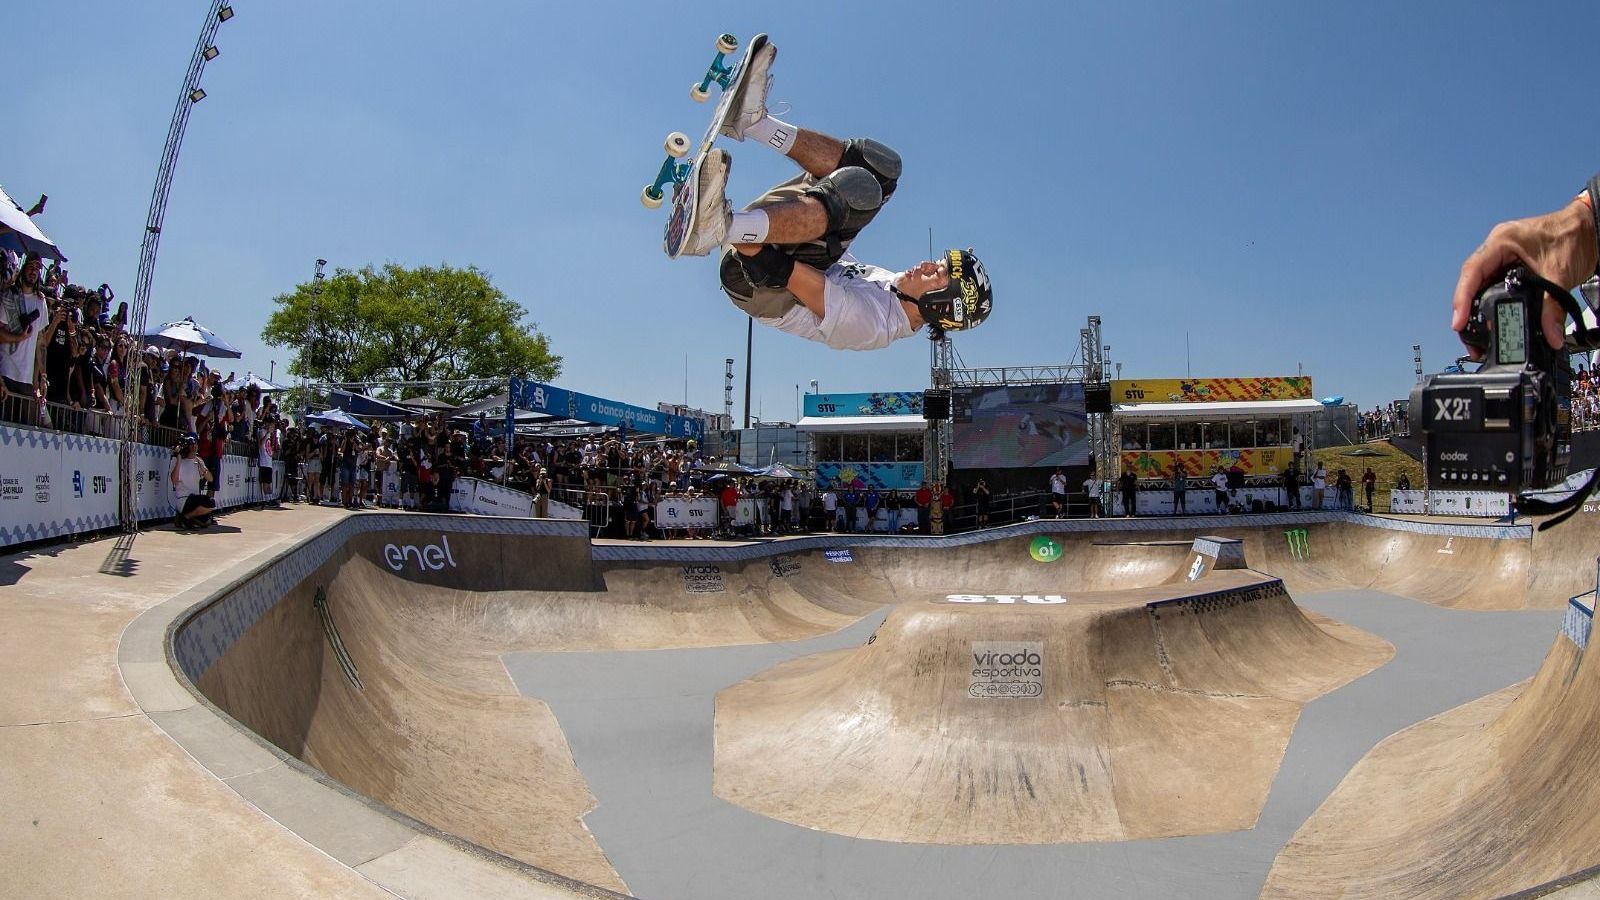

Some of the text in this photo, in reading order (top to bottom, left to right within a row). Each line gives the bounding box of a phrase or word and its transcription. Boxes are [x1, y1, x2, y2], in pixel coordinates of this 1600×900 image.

[1125, 389, 1145, 400] STU
[591, 403, 597, 413] o
[598, 401, 624, 418] banco
[625, 408, 635, 420] do
[636, 411, 657, 425] skate
[817, 403, 836, 413] STU
[93, 475, 106, 494] STU
[688, 509, 704, 517] STU
[384, 534, 457, 571] enel
[1039, 541, 1054, 557] oi
[683, 562, 720, 574] virada
[684, 574, 722, 582] esportiva
[944, 594, 1067, 604] STU
[1240, 590, 1262, 603] VANS
[974, 649, 1041, 666] virada
[972, 666, 1041, 680] esportiva
